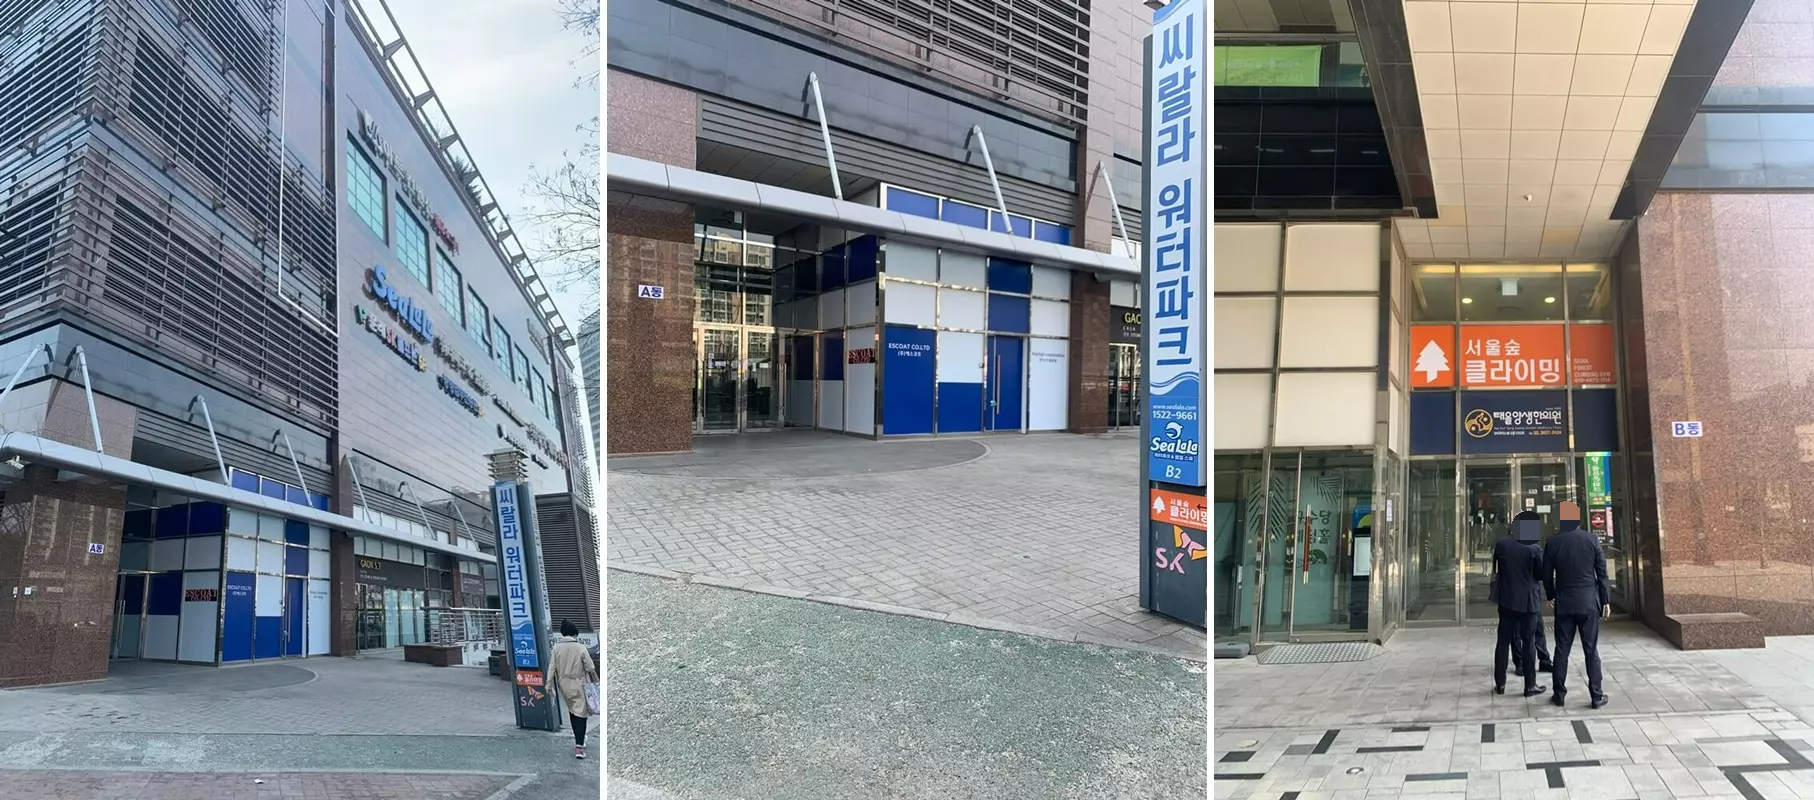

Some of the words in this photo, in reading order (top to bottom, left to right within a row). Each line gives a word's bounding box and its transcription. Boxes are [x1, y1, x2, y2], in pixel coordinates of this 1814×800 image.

[1156, 12, 1197, 167] 씨랄라
[1154, 177, 1194, 367] 워터파크
[640, 285, 663, 298] A동
[888, 342, 910, 350] ESCOAT
[1465, 339, 1521, 356] 서울숲
[1464, 358, 1561, 384] 클라이밍
[1152, 410, 1197, 421] 1522-9661
[1674, 422, 1700, 436] B동
[1165, 464, 1182, 479] B2
[500, 487, 519, 541] 씨랄라
[1156, 547, 1185, 574] SK
[506, 546, 529, 619] 워터파크
[185, 588, 217, 597] ESCOAT
[520, 696, 535, 707] SK
